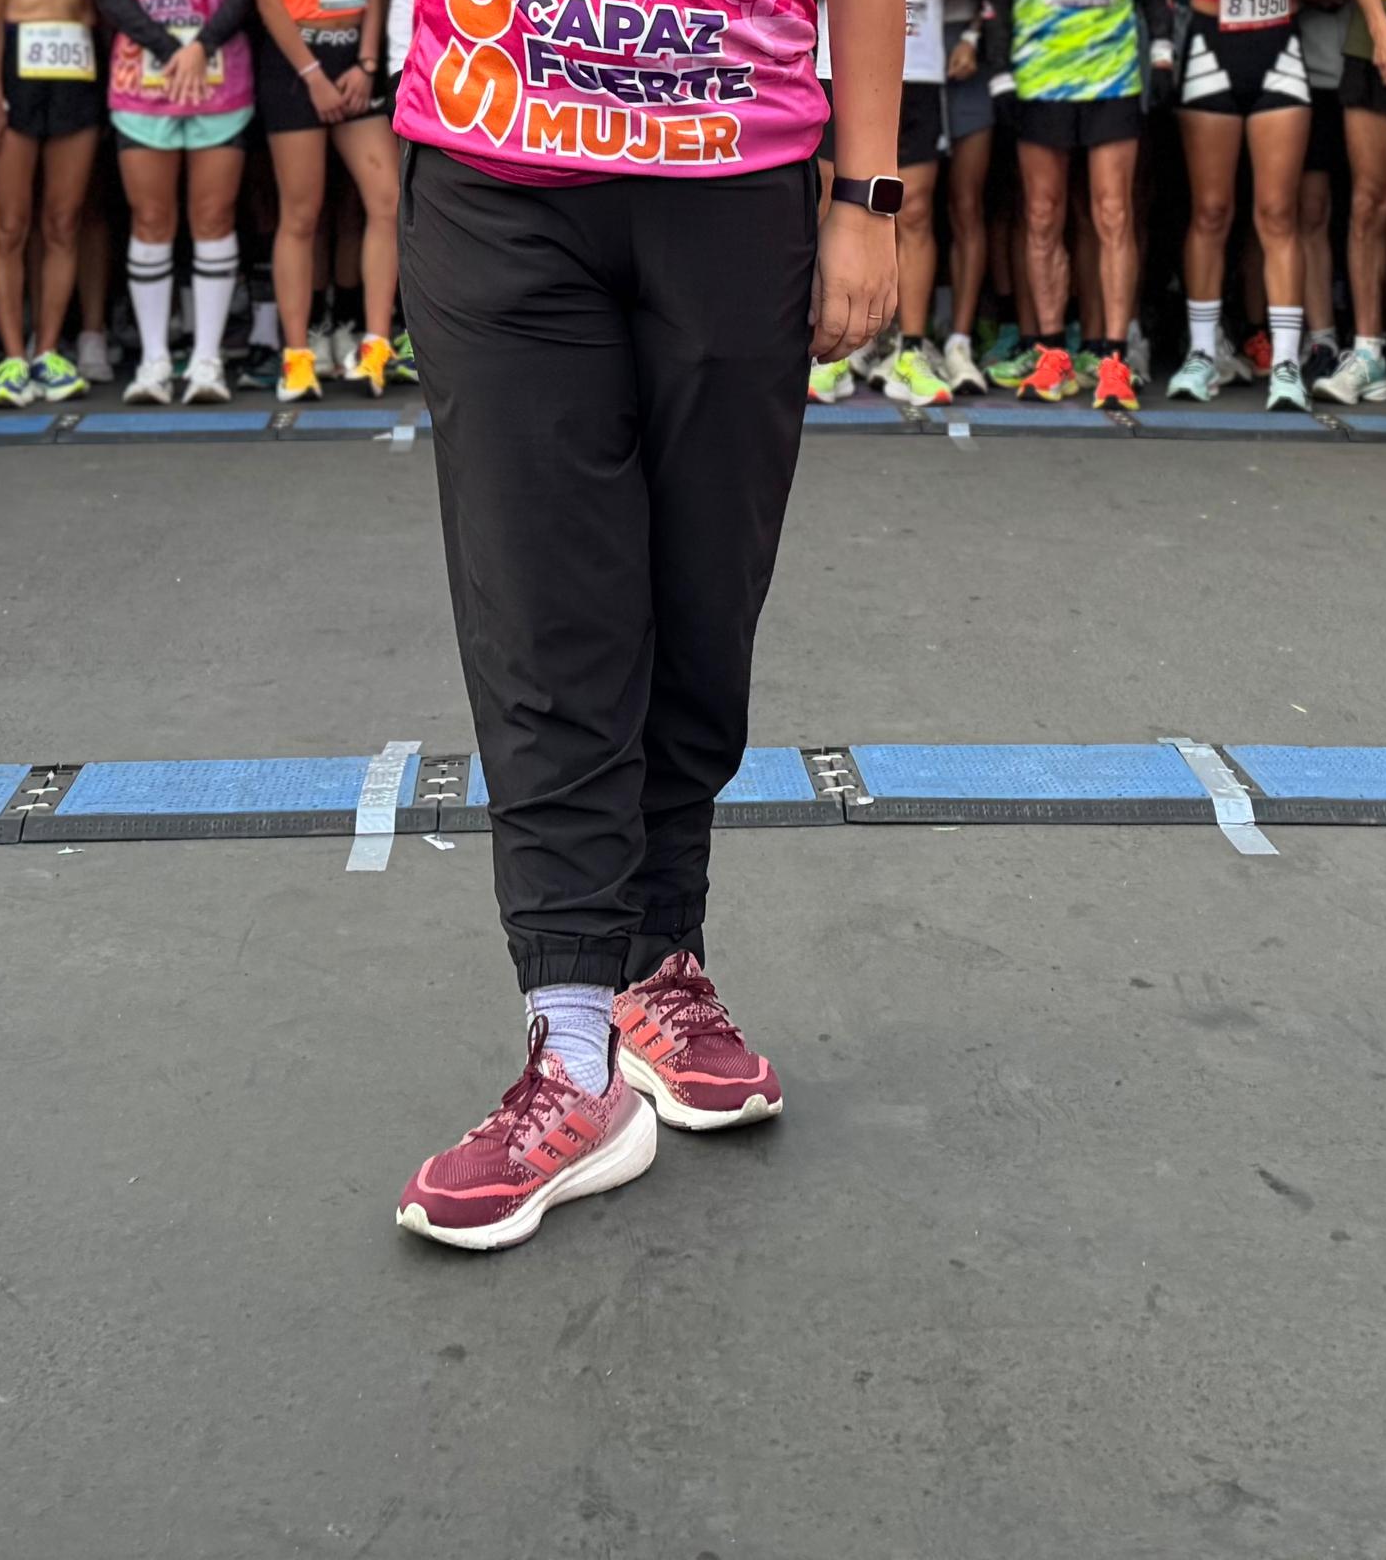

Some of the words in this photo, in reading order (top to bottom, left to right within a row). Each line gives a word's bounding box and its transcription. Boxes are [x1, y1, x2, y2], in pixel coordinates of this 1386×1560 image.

[28, 42, 43, 62] 8
[523, 35, 758, 107] FUERTE
[520, 100, 744, 165] MUJER
